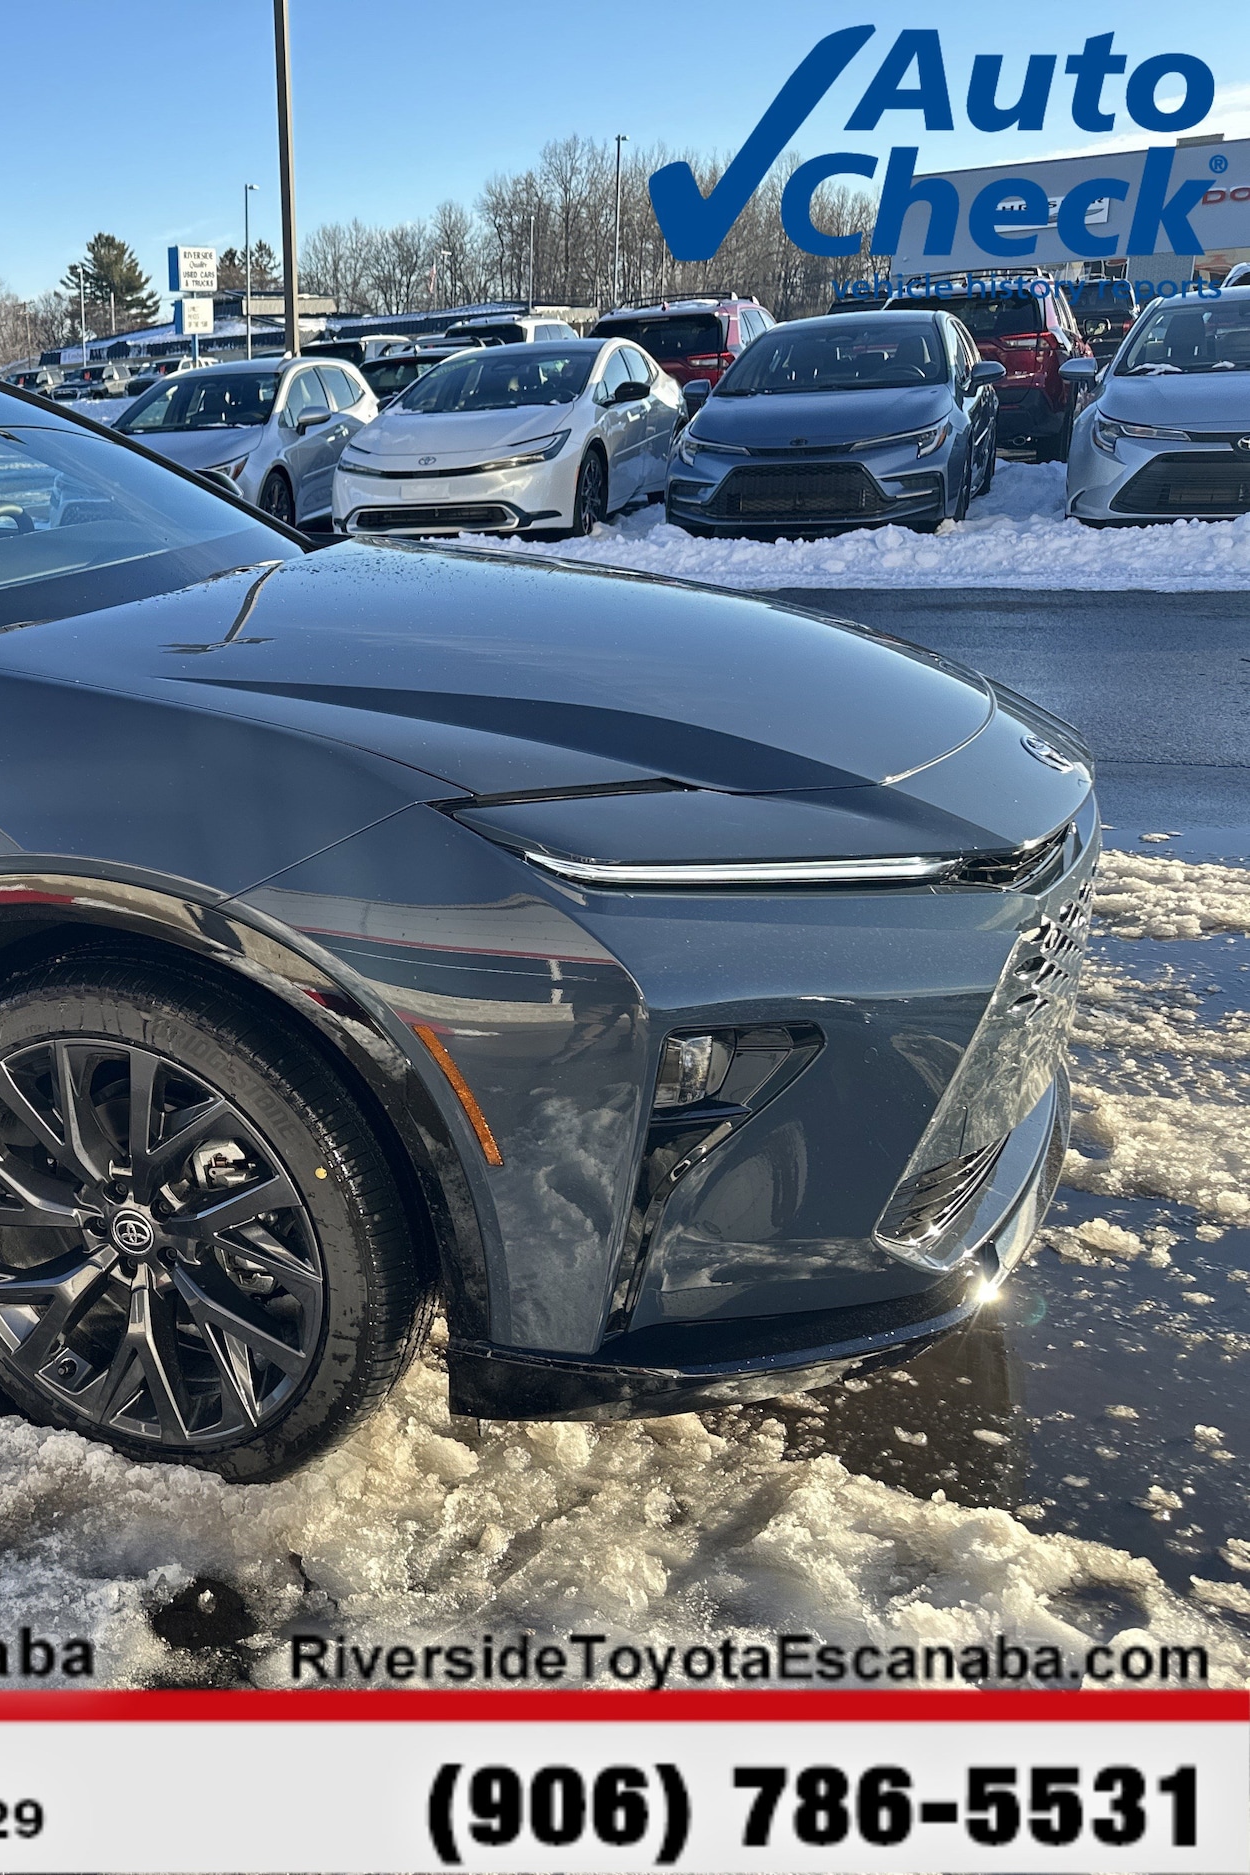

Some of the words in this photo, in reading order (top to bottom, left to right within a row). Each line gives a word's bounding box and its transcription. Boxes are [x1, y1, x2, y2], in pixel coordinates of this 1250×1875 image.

[183, 251, 214, 260] RIVERSIDE
[183, 271, 198, 279] USED
[200, 271, 215, 279] CARS
